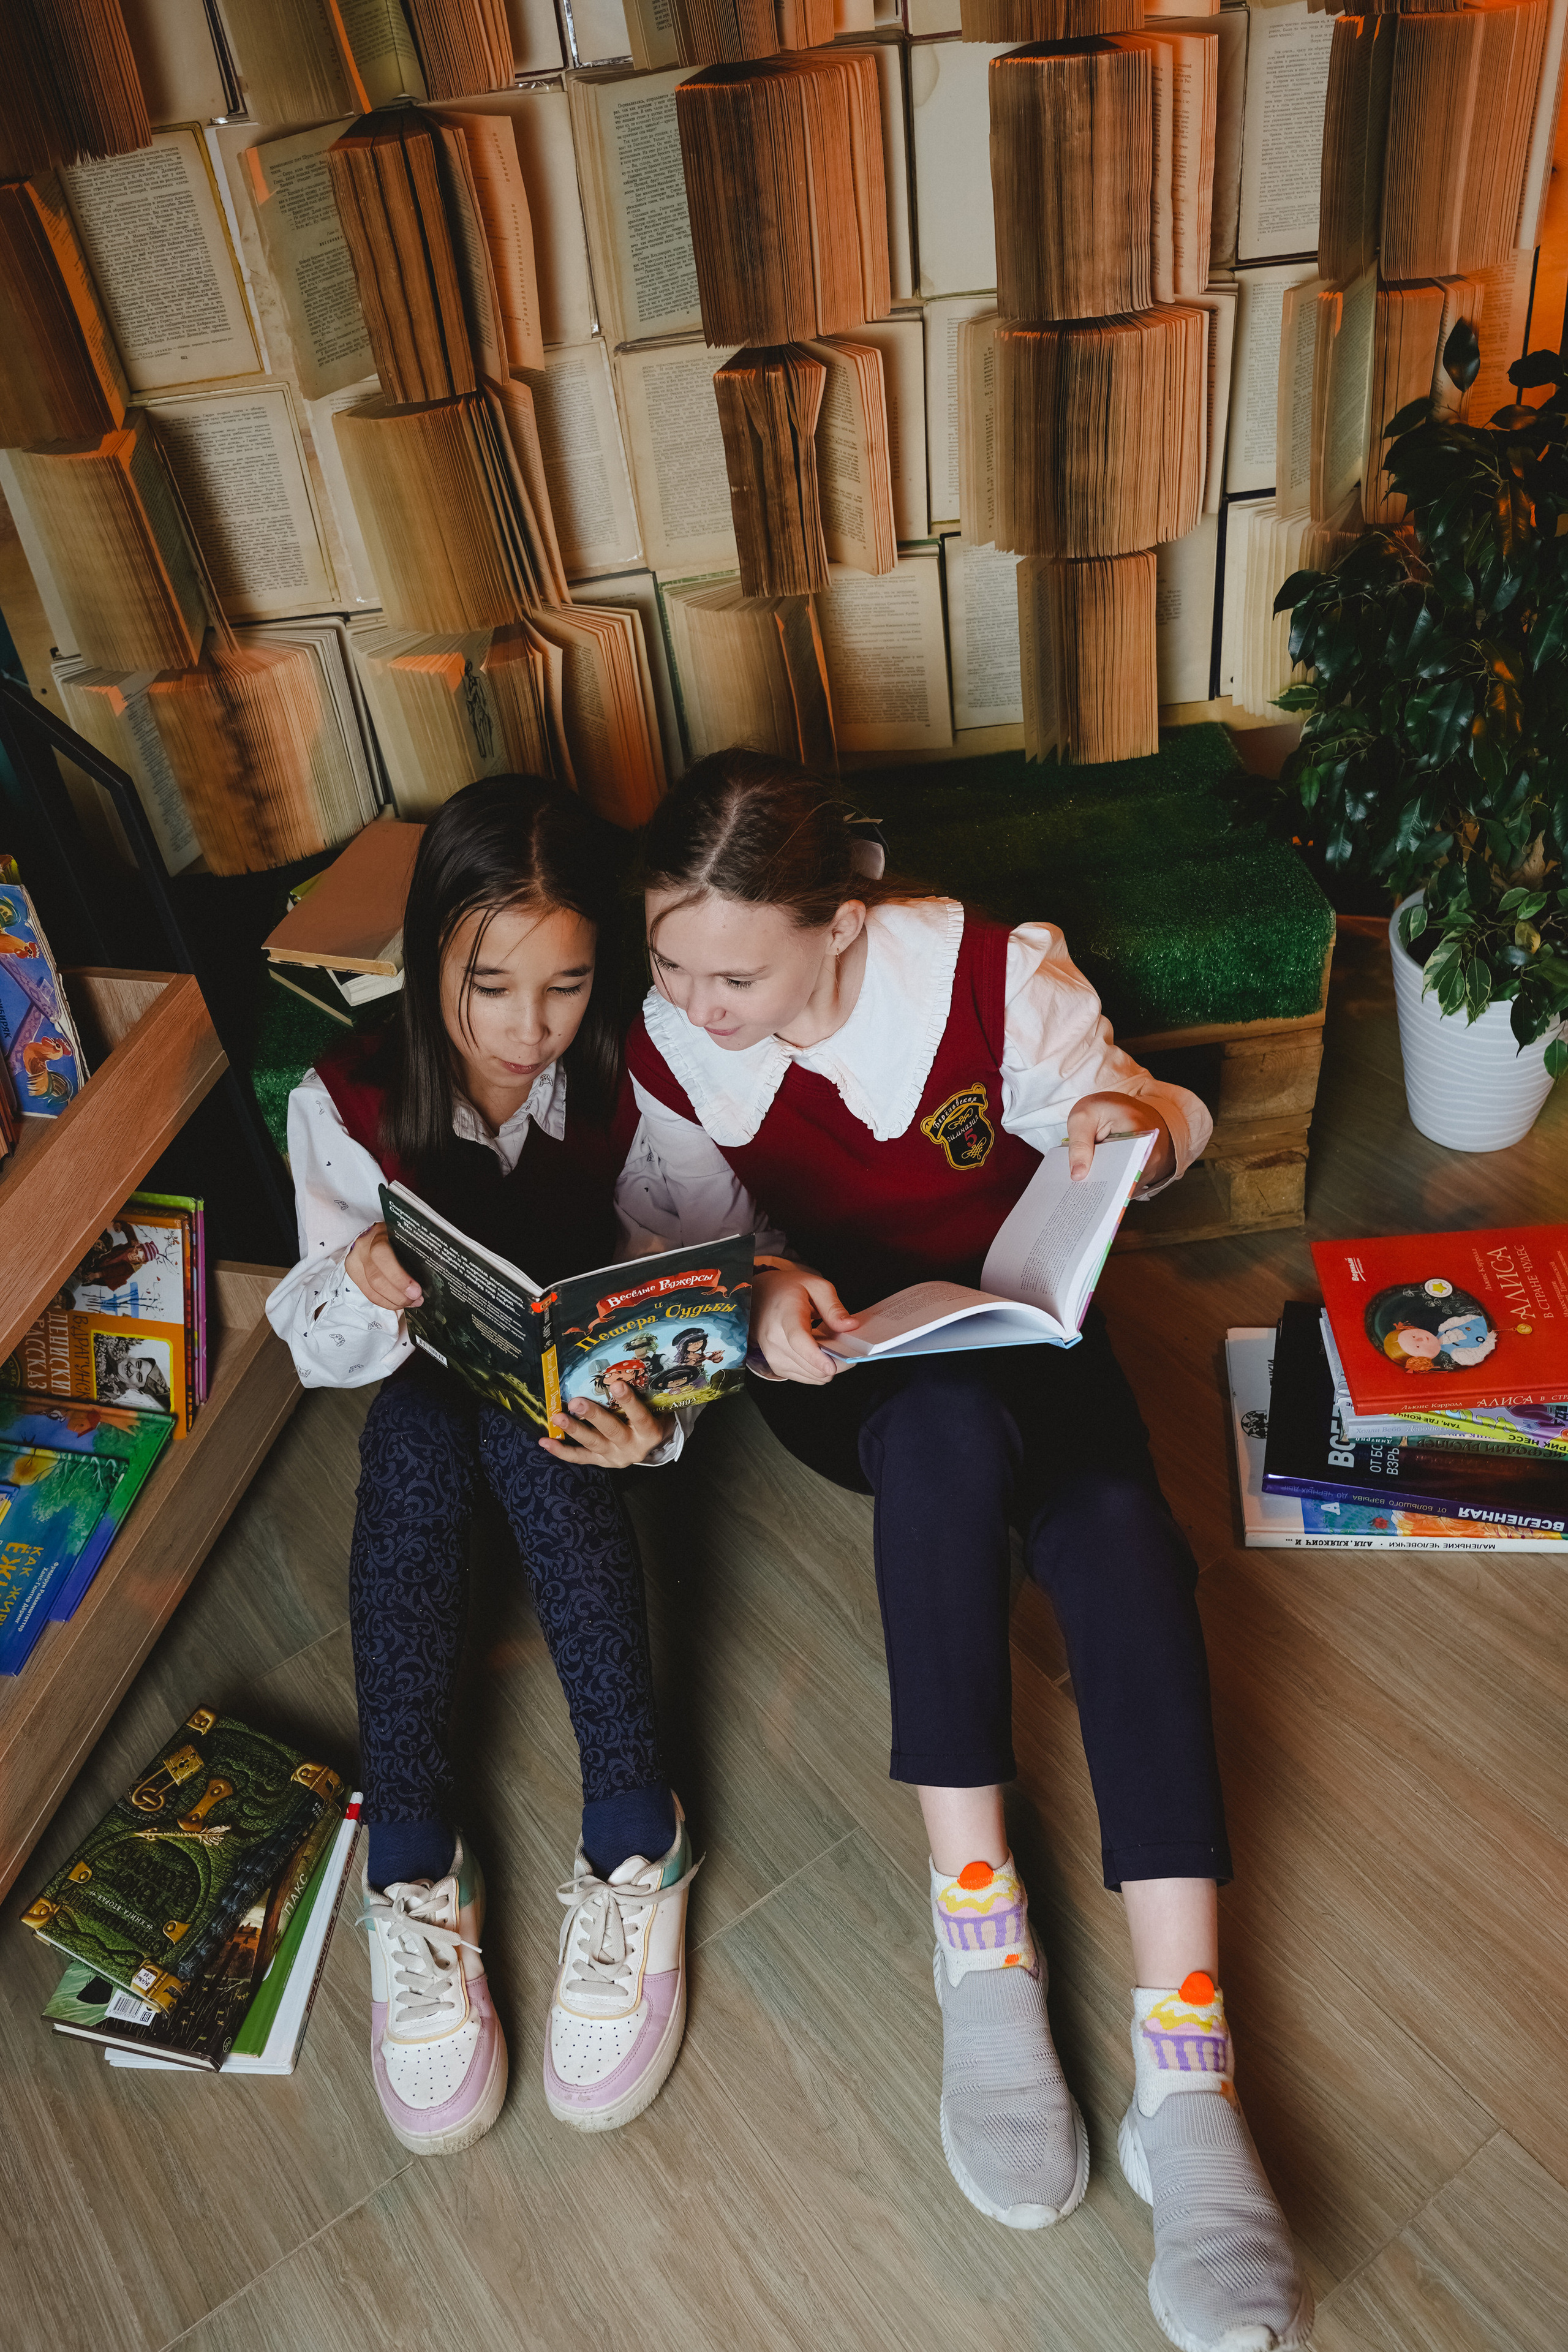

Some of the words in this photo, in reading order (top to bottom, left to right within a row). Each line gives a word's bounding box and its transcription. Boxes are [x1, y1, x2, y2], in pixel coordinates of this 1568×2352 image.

[933, 1096, 977, 1129] Берёзовская
[947, 1114, 979, 1142] гимназия
[964, 1128, 978, 1147] 5
[1344, 1257, 1359, 1281] Верный
[1472, 1248, 1485, 1272] Кэрролл
[1514, 1245, 1532, 1273] ЧУДЕС
[606, 1284, 655, 1308] Весёлые
[659, 1274, 713, 1291] Роджерсы
[1482, 1273, 1493, 1292] Льюис
[1487, 1246, 1536, 1319] АЛИСА
[1528, 1275, 1550, 1310] СТРАНЕ
[541, 1299, 551, 1309] 6+
[575, 1315, 658, 1352] Пещера
[665, 1303, 737, 1319] Судьбы
[669, 1396, 696, 1409] Дудл
[1477, 1395, 1533, 1407] АЛИСА
[1509, 1434, 1539, 1446] НЕСС
[1370, 1459, 1382, 1472] ОТ
[1352, 1495, 1385, 1504] ВЗРЫВА
[1389, 1500, 1433, 1512] БОЛЬШОГО
[1458, 1507, 1565, 1532] ВСЕЛЕННАЯ
[19, 1547, 44, 1577] КАК
[26, 1567, 48, 1603] Ханс-Гюнтер
[42, 1562, 59, 1588] Фридерун
[15, 1604, 29, 1623] Дёринг
[18, 1589, 45, 1632] Райхенштеттер
[97, 1894, 122, 1912] ВТОРАЯ
[284, 1874, 307, 1915] ПАКС
[123, 1909, 146, 1926] КНИГА
[306, 1915, 335, 2013] ПРИКЛЮЧЕНИЯ
[334, 1881, 345, 1910] ТОМА
[344, 1831, 358, 1875] СОЙЕРА
